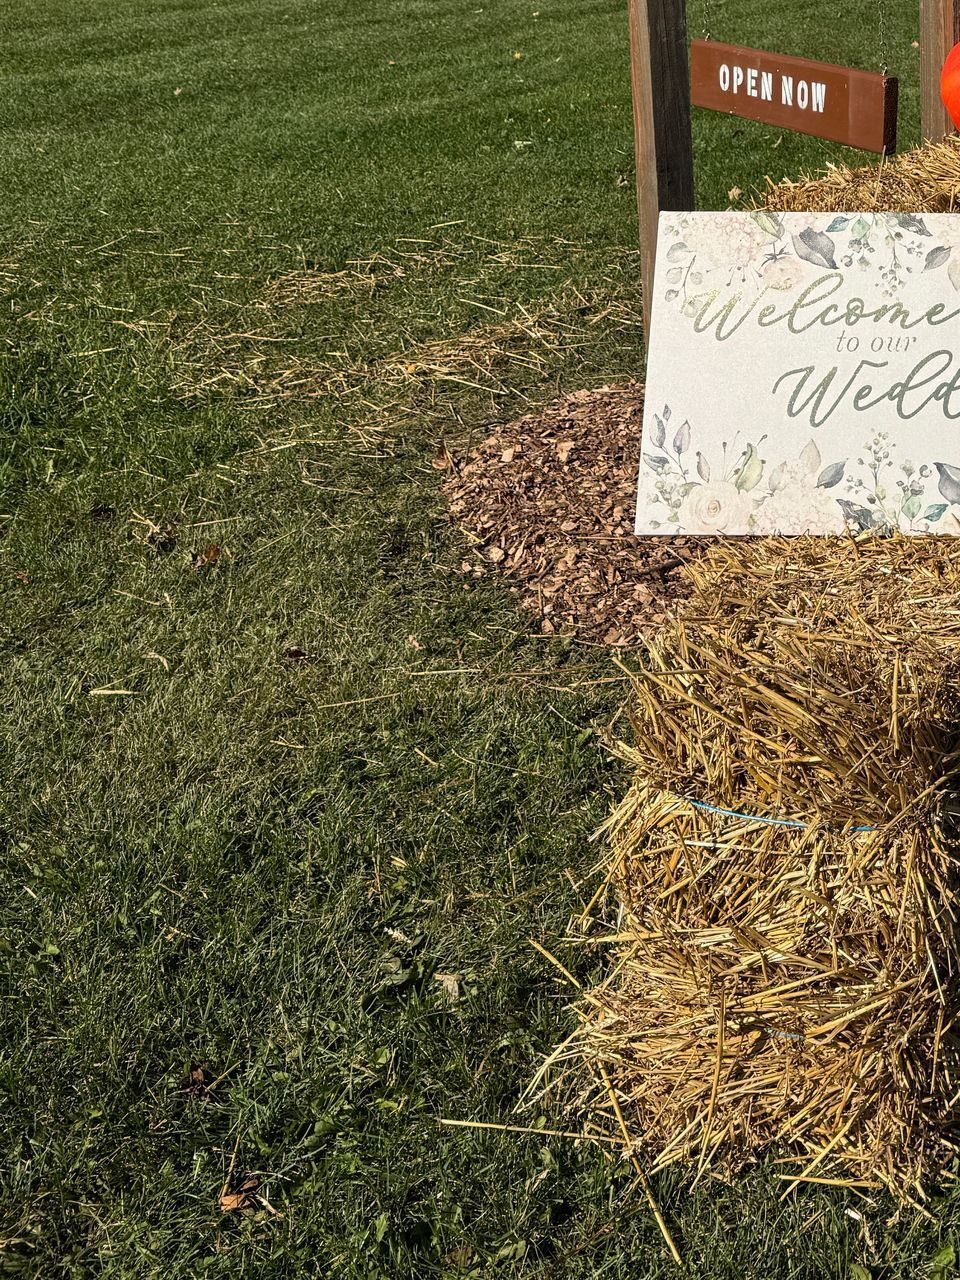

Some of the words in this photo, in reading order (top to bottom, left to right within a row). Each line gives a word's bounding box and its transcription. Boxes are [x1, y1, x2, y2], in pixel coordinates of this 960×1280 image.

[719, 64, 773, 102] OPEN
[781, 75, 827, 113] NOW
[836, 330, 860, 353] to
[871, 335, 917, 354] our
